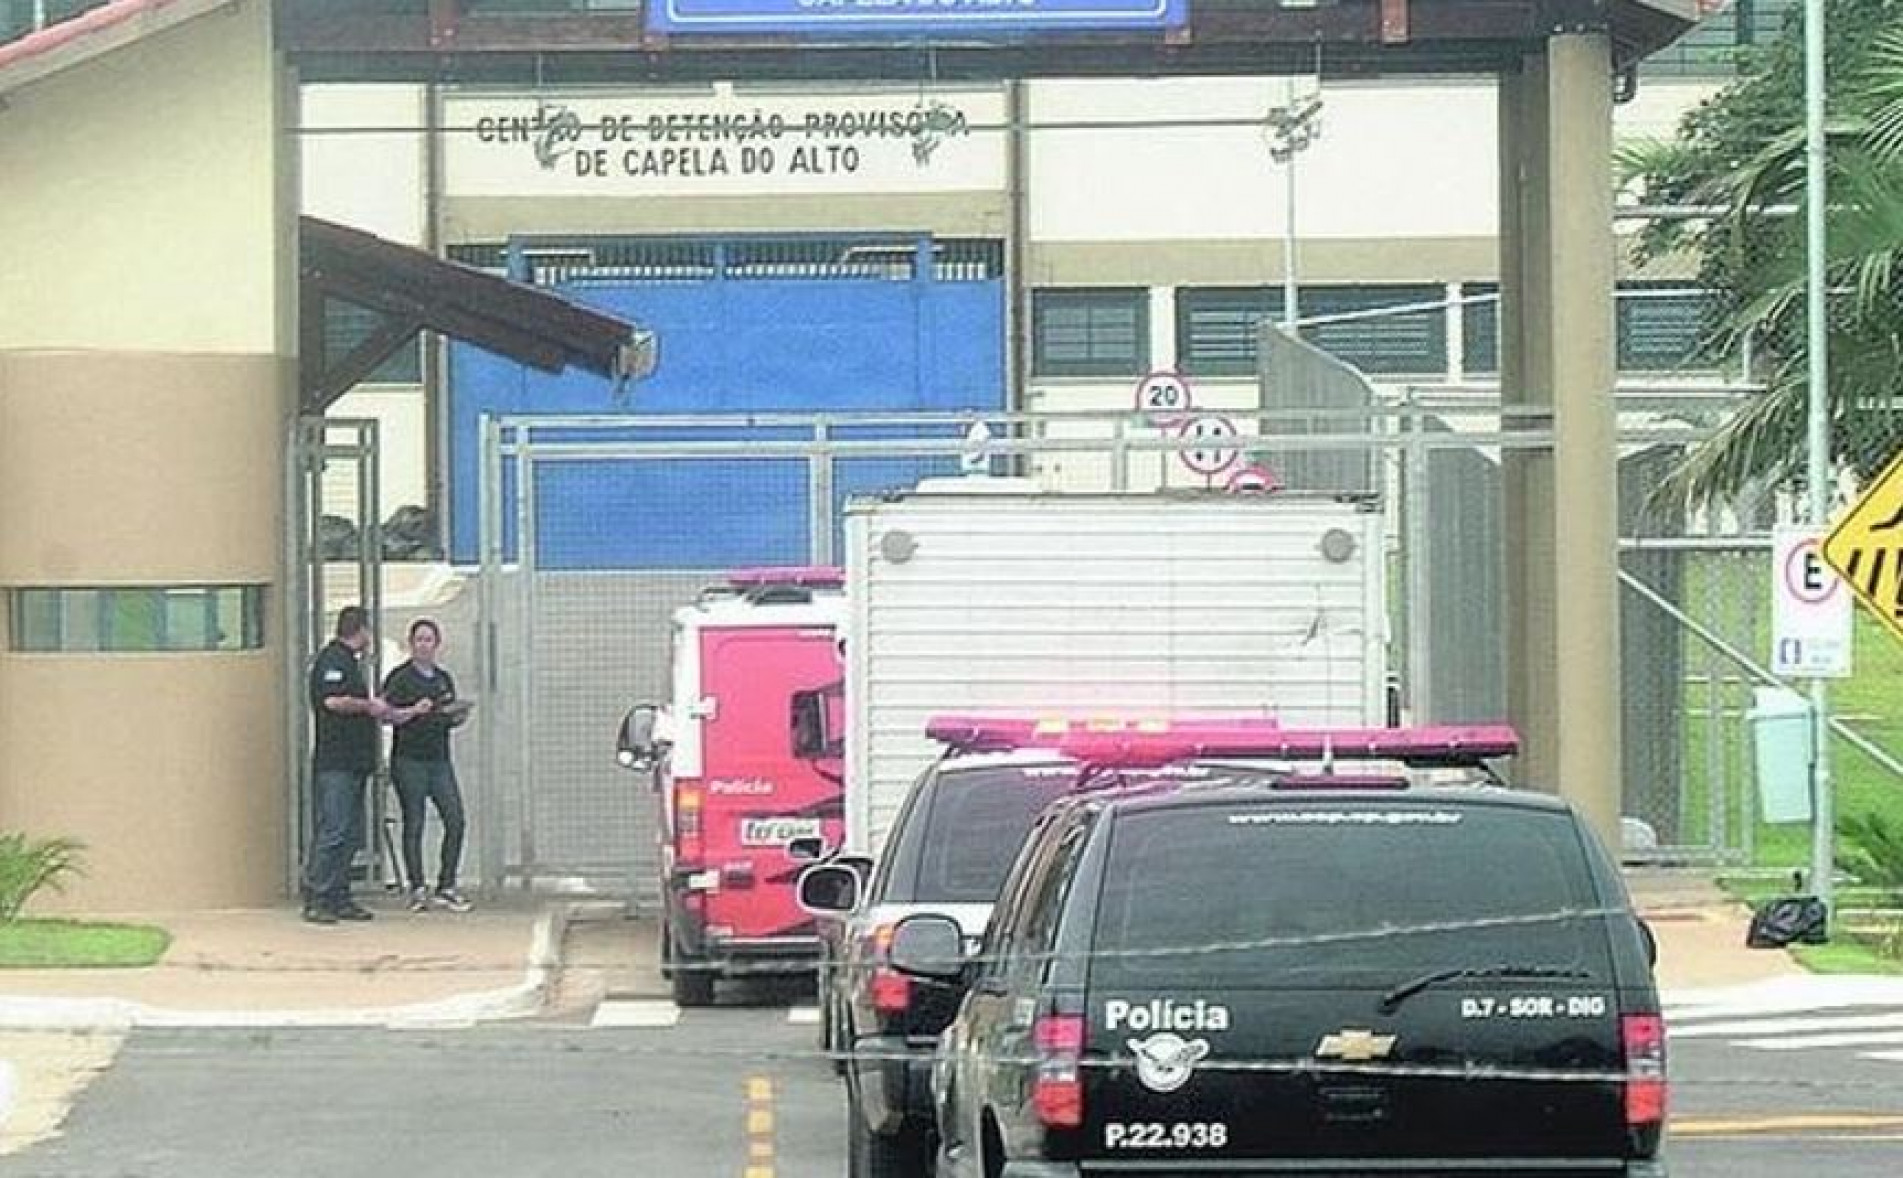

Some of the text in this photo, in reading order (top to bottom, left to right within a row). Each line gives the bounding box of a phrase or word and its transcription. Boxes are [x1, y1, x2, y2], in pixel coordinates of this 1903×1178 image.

[477, 115, 581, 142] CENTO
[602, 115, 632, 142] DE
[650, 108, 784, 143] DETENÇÃO
[576, 146, 860, 177] DE CAPELA DO ALTO
[1149, 385, 1179, 407] 20
[1804, 553, 1823, 590] E
[1105, 999, 1230, 1031] Polícia
[1105, 1122, 1228, 1149] P.22.938
